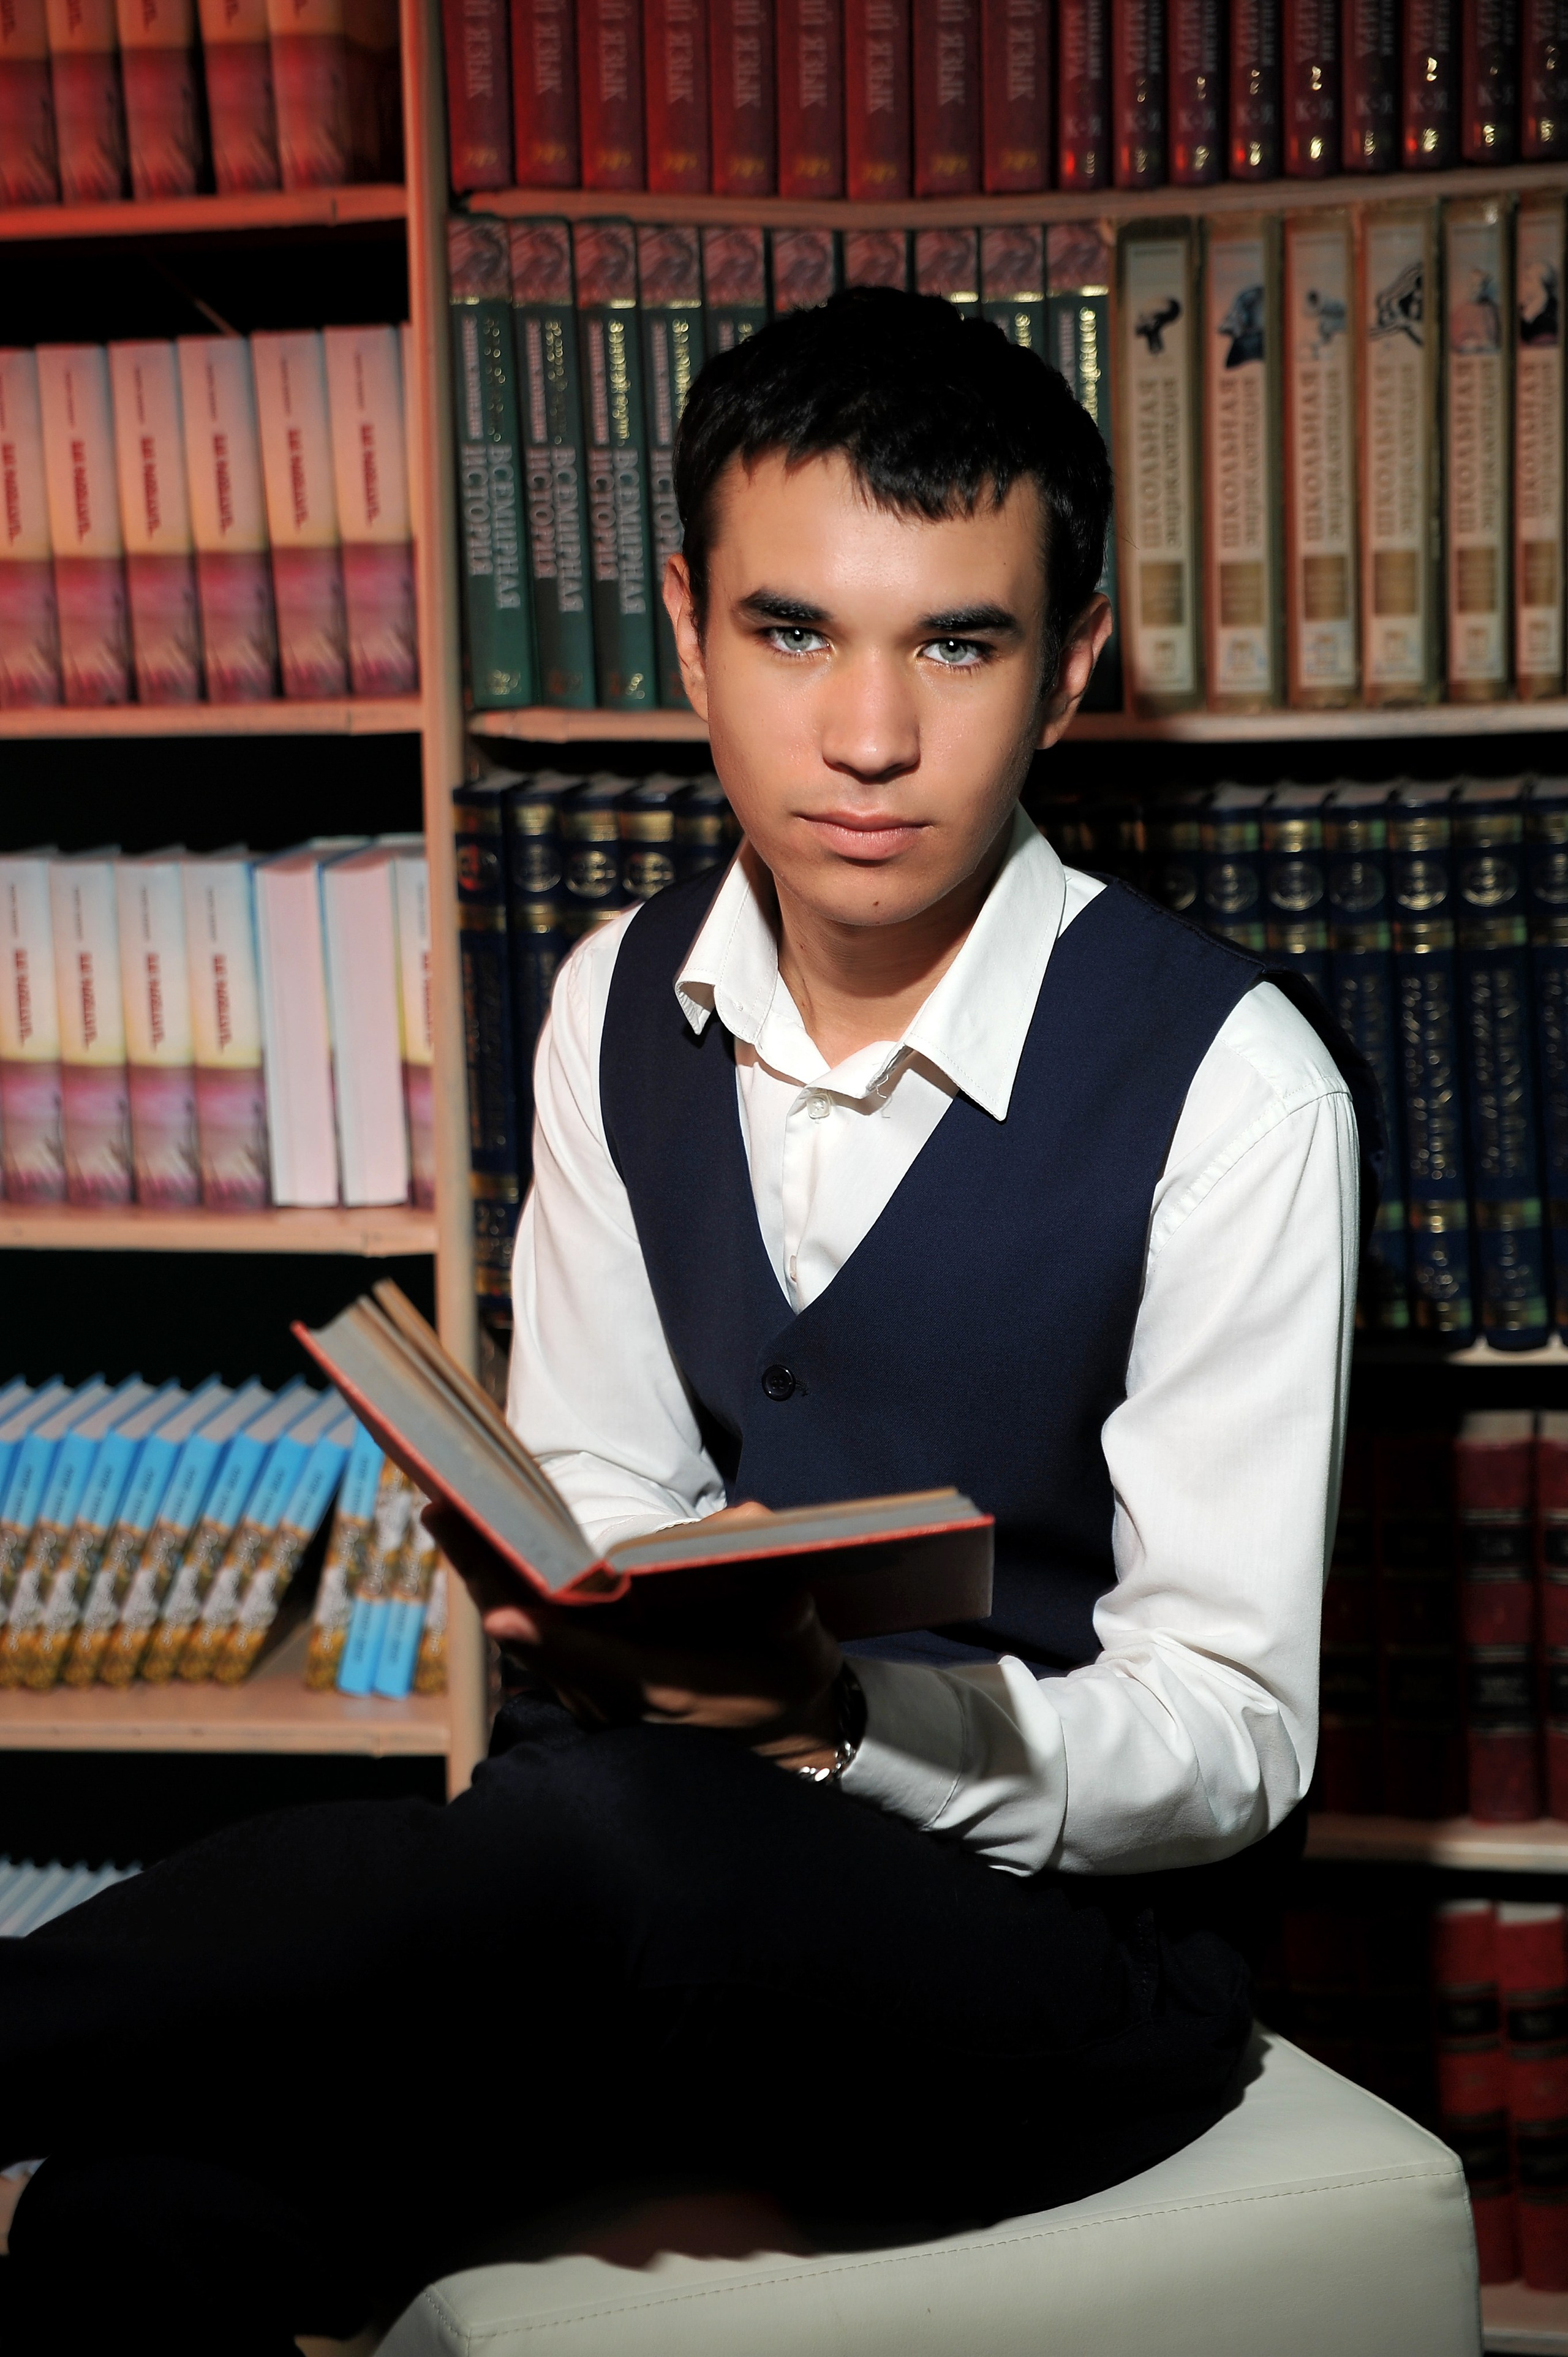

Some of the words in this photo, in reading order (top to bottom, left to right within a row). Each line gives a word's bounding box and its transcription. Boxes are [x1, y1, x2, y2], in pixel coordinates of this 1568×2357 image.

[462, 445, 493, 576] ИСТОРИЯ
[488, 444, 521, 610] ВСЕМИРНАЯ
[526, 447, 557, 579] ИСТОРИЯ
[551, 446, 585, 613] ВСЕМИРНАЯ
[589, 449, 620, 581] ИСТОРИЯ
[614, 448, 647, 615] ВСЕМИРНАЯ
